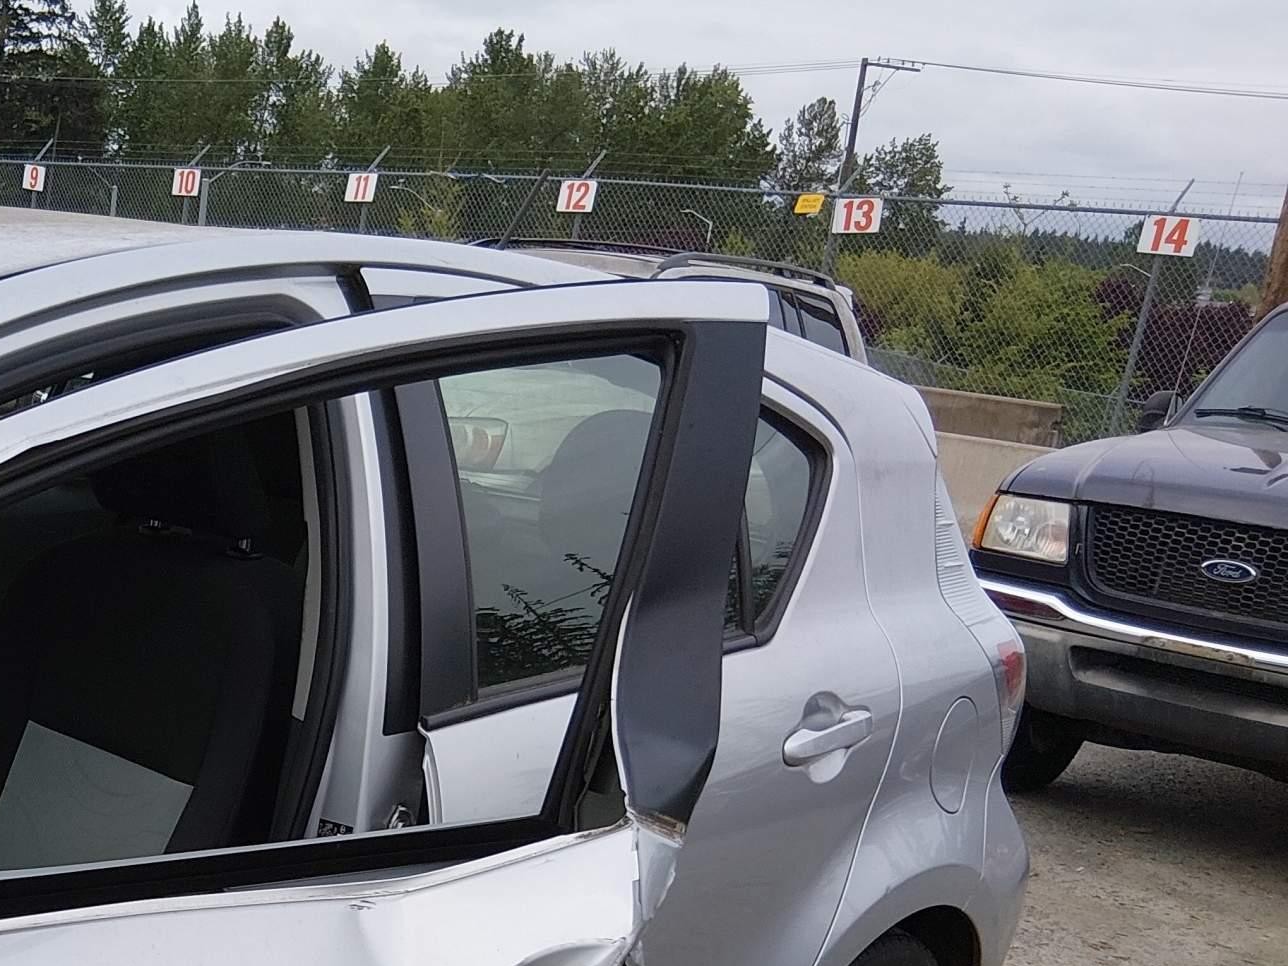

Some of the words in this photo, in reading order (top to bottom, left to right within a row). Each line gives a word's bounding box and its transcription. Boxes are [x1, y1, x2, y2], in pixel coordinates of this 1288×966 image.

[29, 167, 39, 189] 9
[178, 170, 198, 196] 10
[353, 175, 372, 200] 11
[565, 181, 592, 211] 12
[843, 199, 875, 232] 13
[1150, 217, 1190, 254] 14
[1213, 563, 1242, 579] Ford
